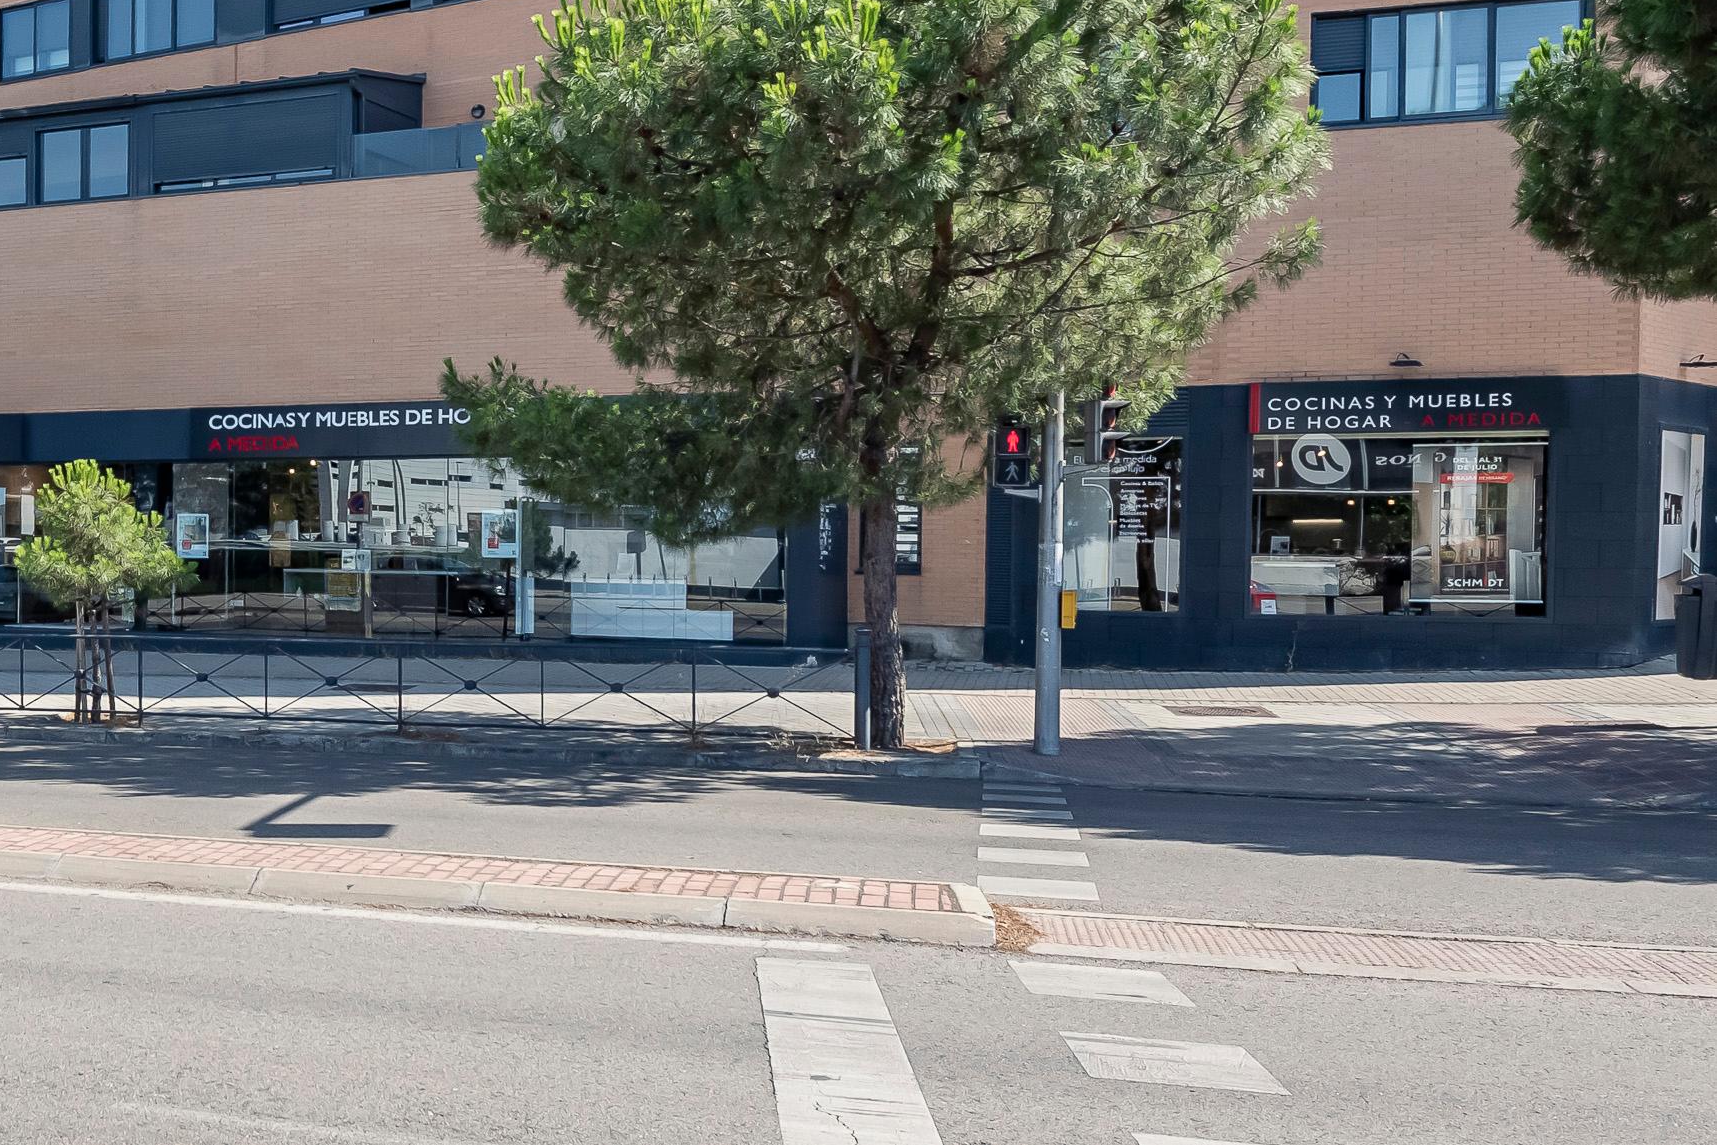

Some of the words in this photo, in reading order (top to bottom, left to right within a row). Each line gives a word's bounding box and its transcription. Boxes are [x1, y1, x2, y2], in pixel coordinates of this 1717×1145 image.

[1268, 396, 1375, 411] COCINAS
[1384, 395, 1396, 409] Y
[1409, 393, 1513, 408] MUEBLES
[209, 413, 296, 430] COCINAS
[298, 412, 311, 427] Y
[315, 410, 399, 428] MUEBLES
[405, 409, 433, 425] DE
[438, 408, 472, 425] HO
[1268, 416, 1296, 430] DE
[1307, 415, 1392, 430] HOGAR
[1420, 415, 1435, 426] A
[1447, 412, 1541, 428] MEDIDA
[208, 438, 222, 452] A
[228, 435, 299, 453] MEDIDA
[1122, 455, 1158, 464] medida
